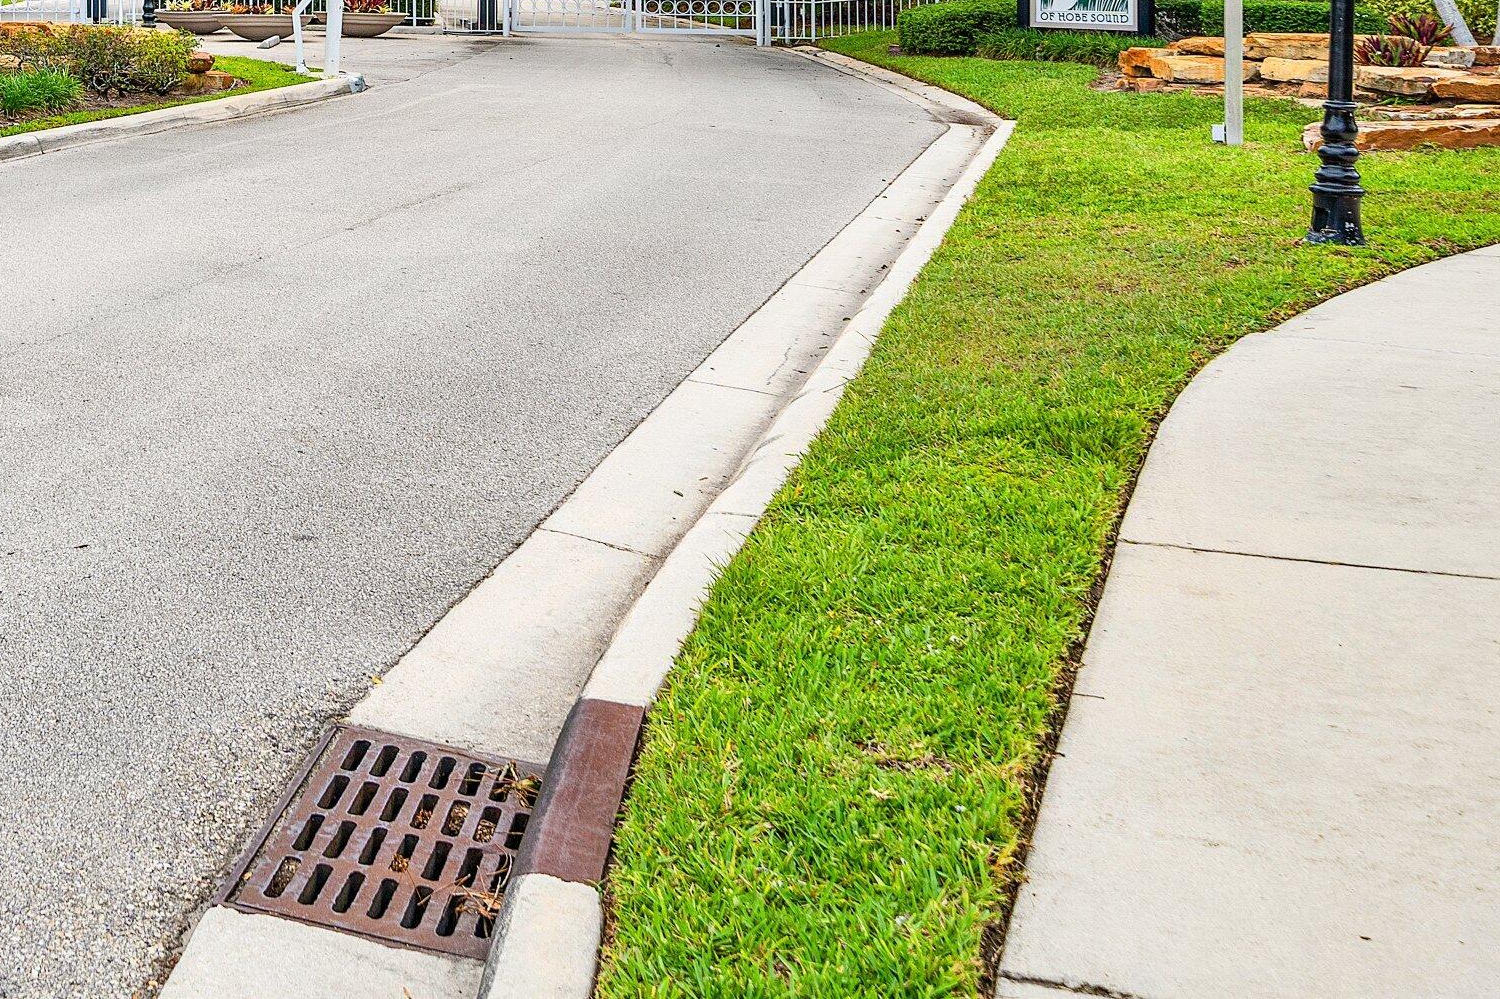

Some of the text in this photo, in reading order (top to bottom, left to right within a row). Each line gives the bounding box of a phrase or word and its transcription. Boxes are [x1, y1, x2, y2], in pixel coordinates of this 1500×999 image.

[1041, 12, 1129, 23] OF HOBE SOUND
